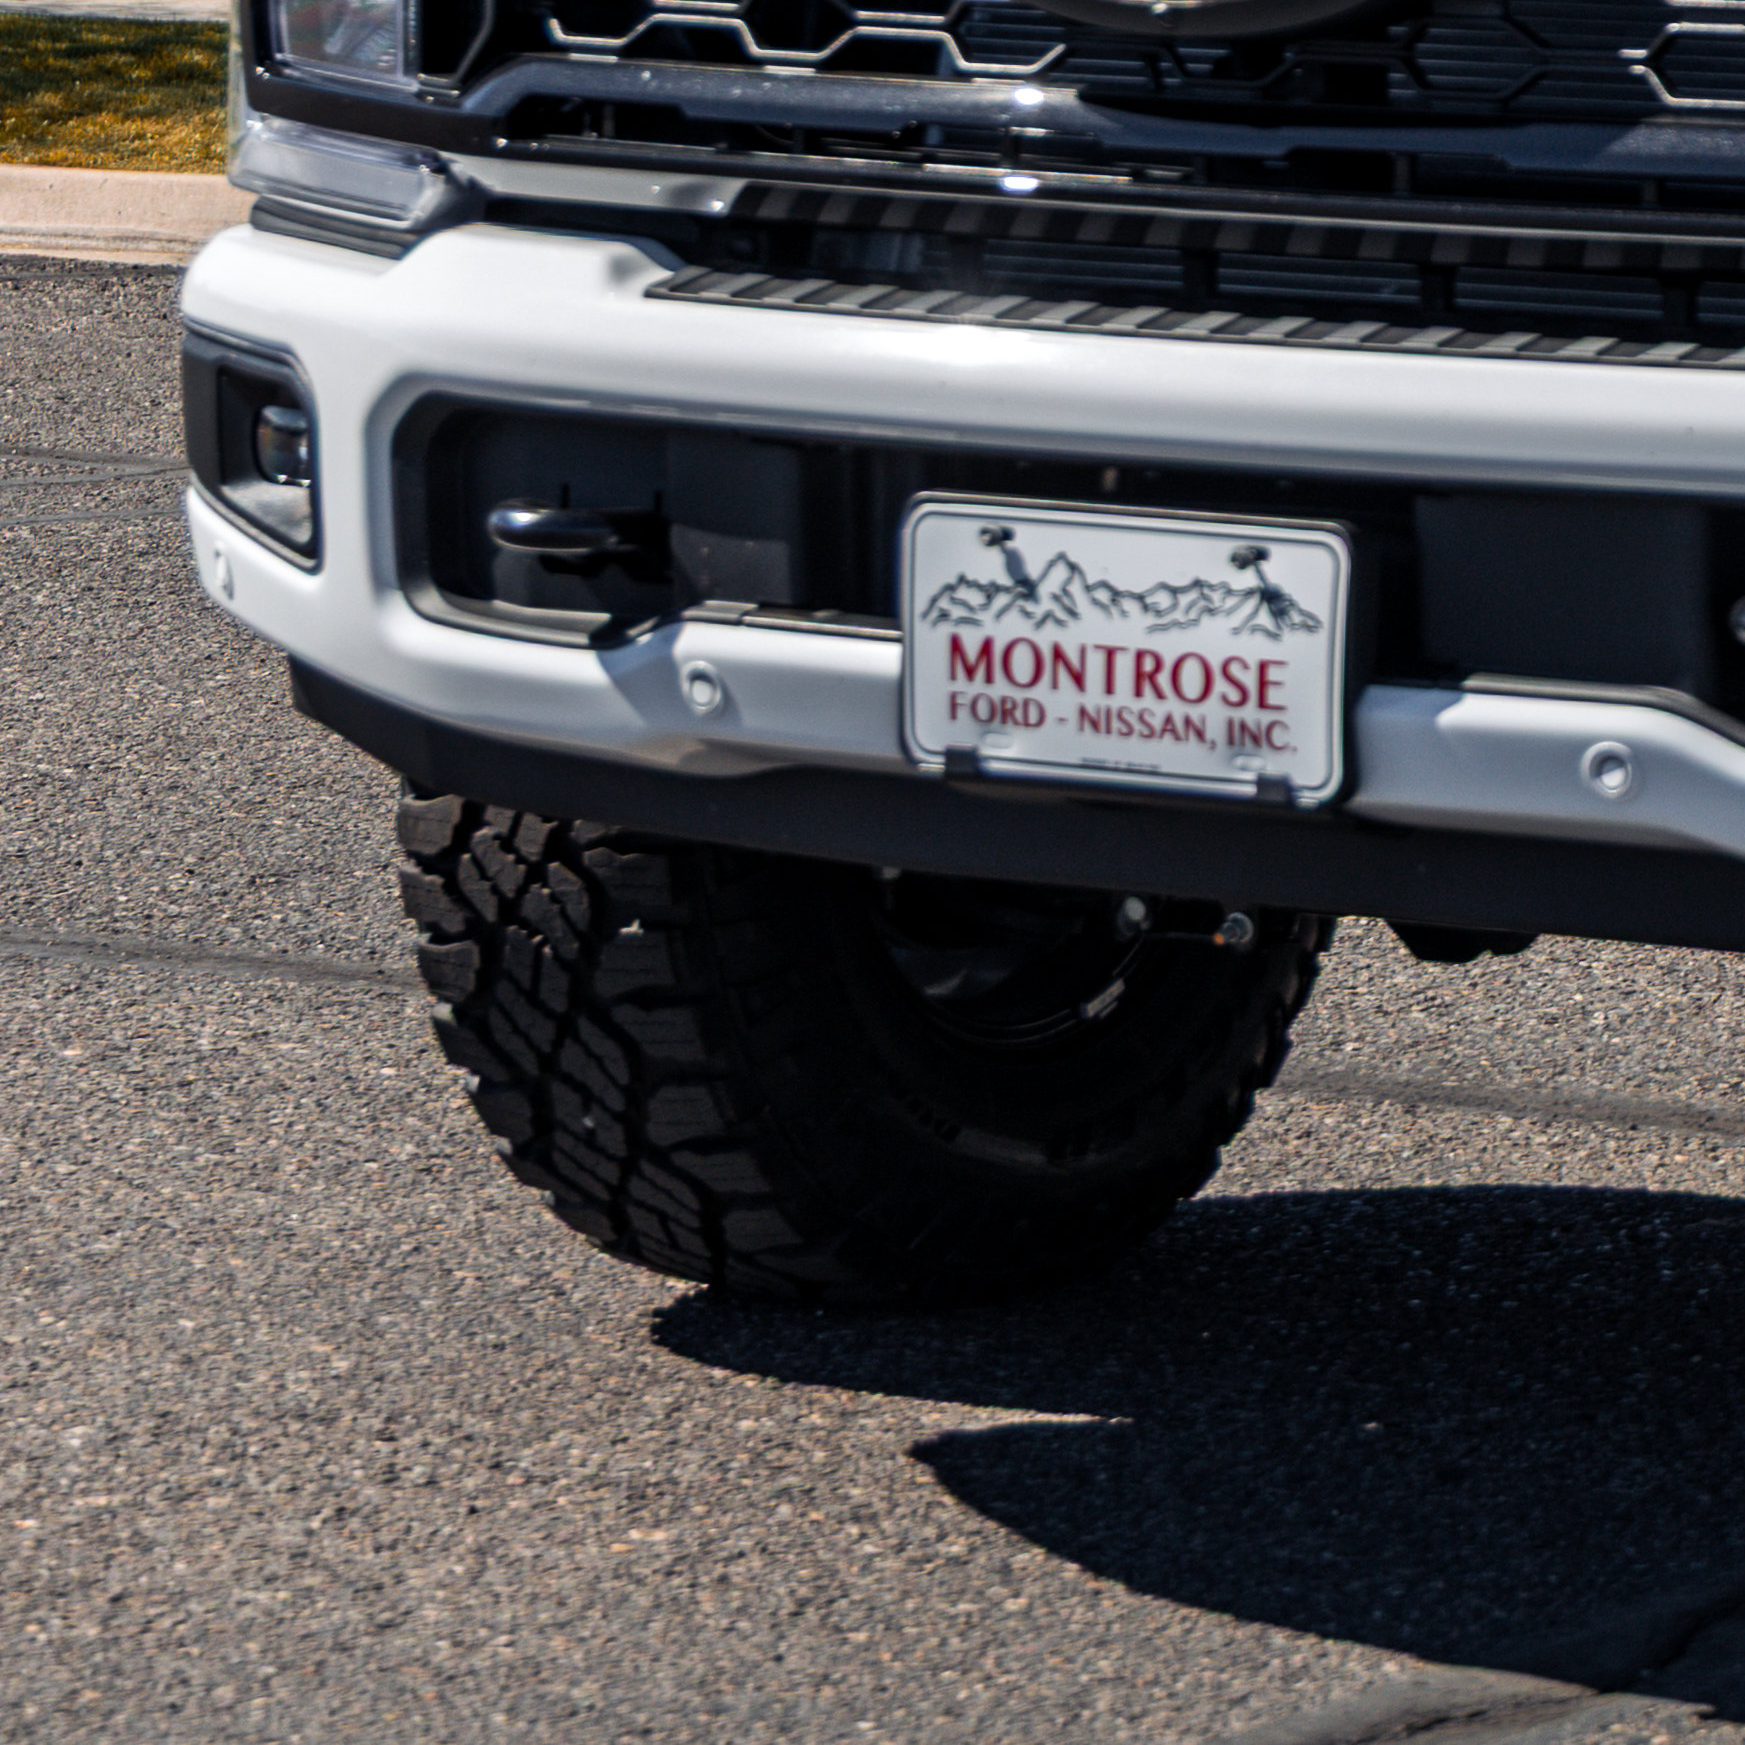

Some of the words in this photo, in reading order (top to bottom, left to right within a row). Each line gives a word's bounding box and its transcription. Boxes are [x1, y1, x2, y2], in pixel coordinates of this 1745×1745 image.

[949, 632, 1289, 711] MONTROSE
[949, 691, 1047, 728] FORD
[1078, 703, 1218, 752] NISSAN,
[1226, 719, 1298, 753] INC.
